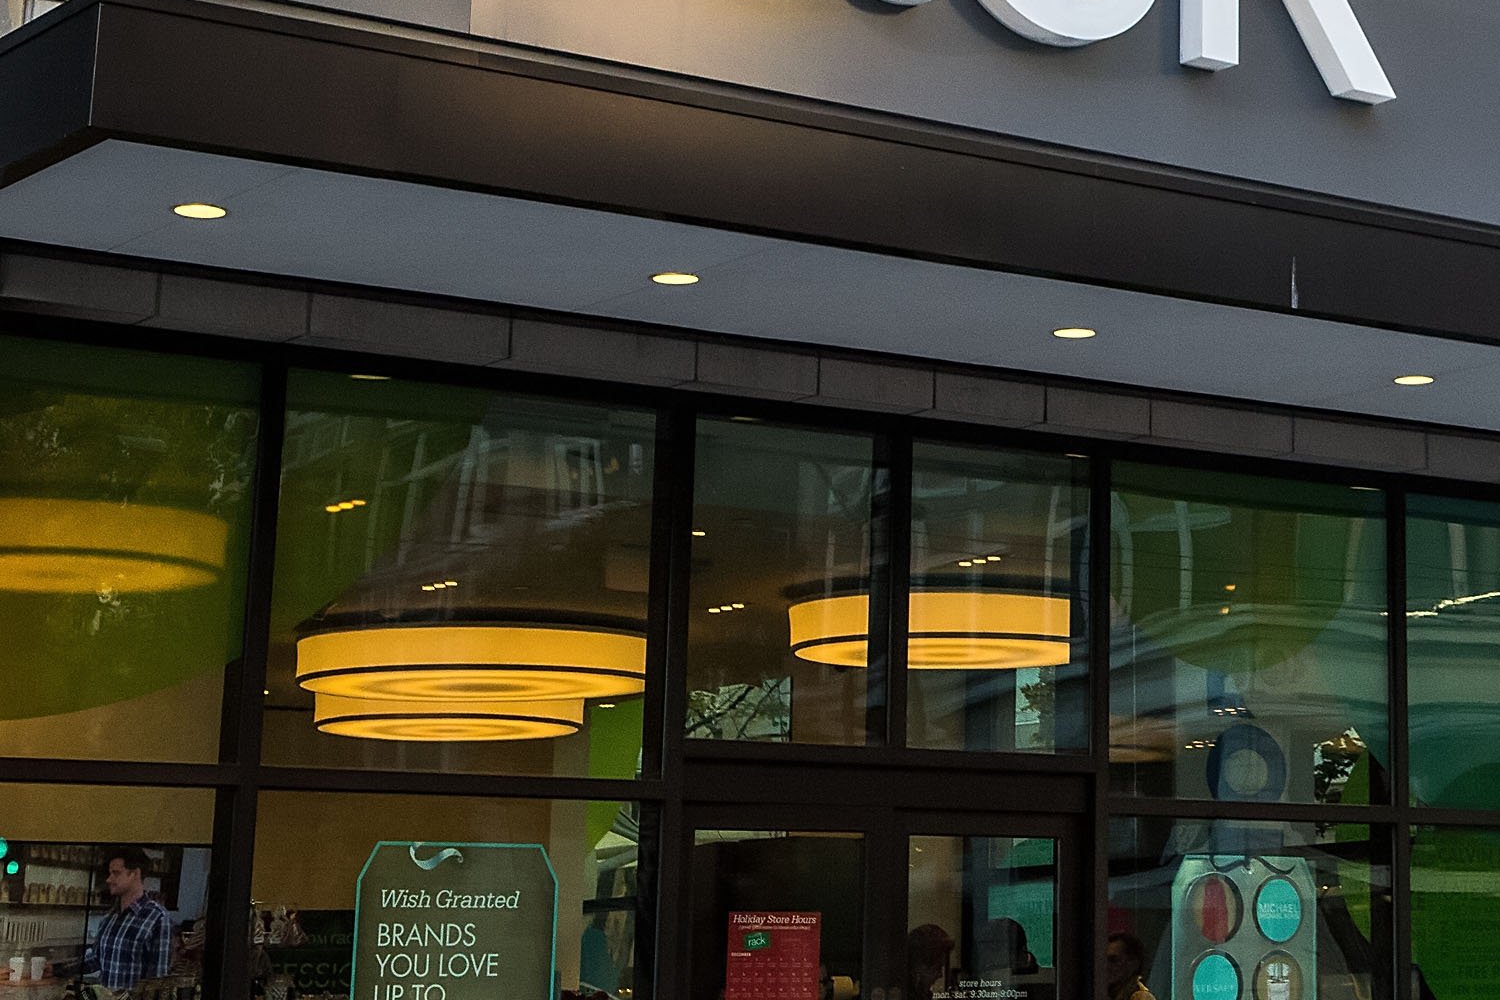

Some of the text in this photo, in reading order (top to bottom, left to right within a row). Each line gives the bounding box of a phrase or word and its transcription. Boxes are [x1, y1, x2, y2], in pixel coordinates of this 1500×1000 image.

[381, 889, 520, 909] Wish Granted
[733, 914, 817, 925] Holiday Store Hours
[377, 922, 476, 947] BRANDS
[375, 953, 430, 978] YOU
[439, 953, 499, 977] LOVE
[374, 984, 446, 1000] UP TO
[959, 978, 1002, 988] store hours
